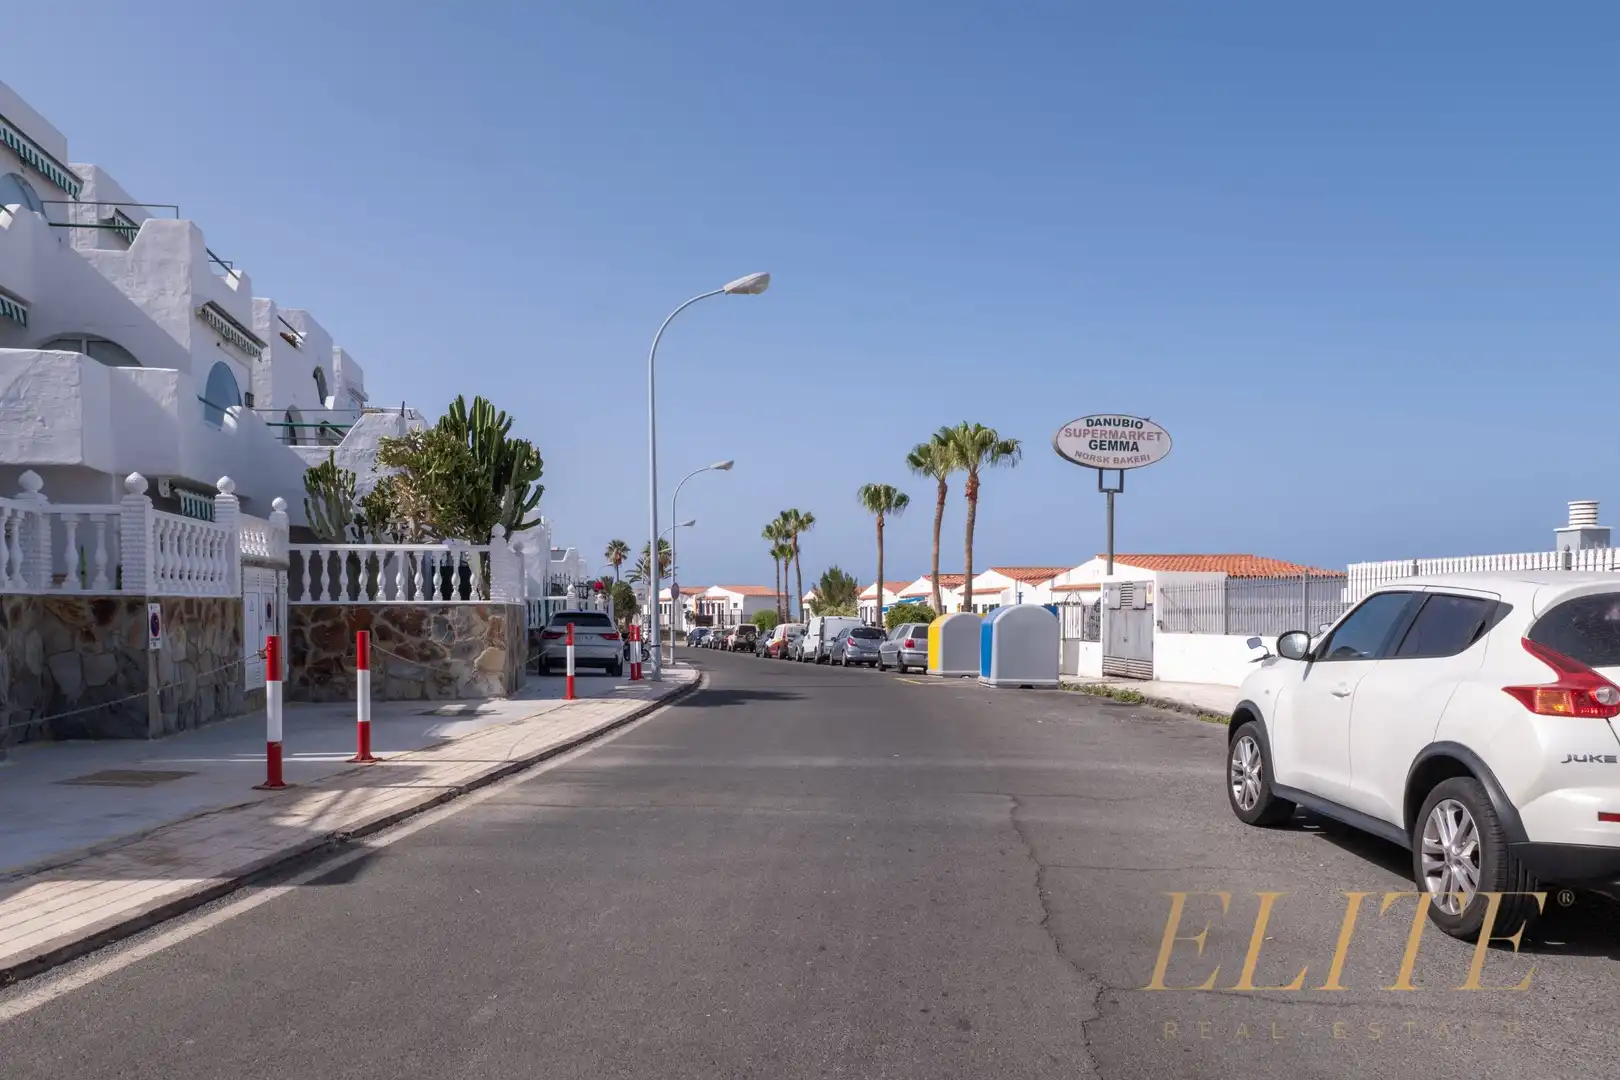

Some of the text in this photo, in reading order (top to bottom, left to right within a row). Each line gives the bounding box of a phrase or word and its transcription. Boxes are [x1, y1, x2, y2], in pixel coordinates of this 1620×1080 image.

[1086, 418, 1144, 429] DANUBIO
[1064, 428, 1162, 441] SUPERMARKET
[1088, 439, 1140, 452] GEMMA
[1074, 450, 1151, 464] NORSK BAKERI
[1560, 753, 1618, 764] JUKE
